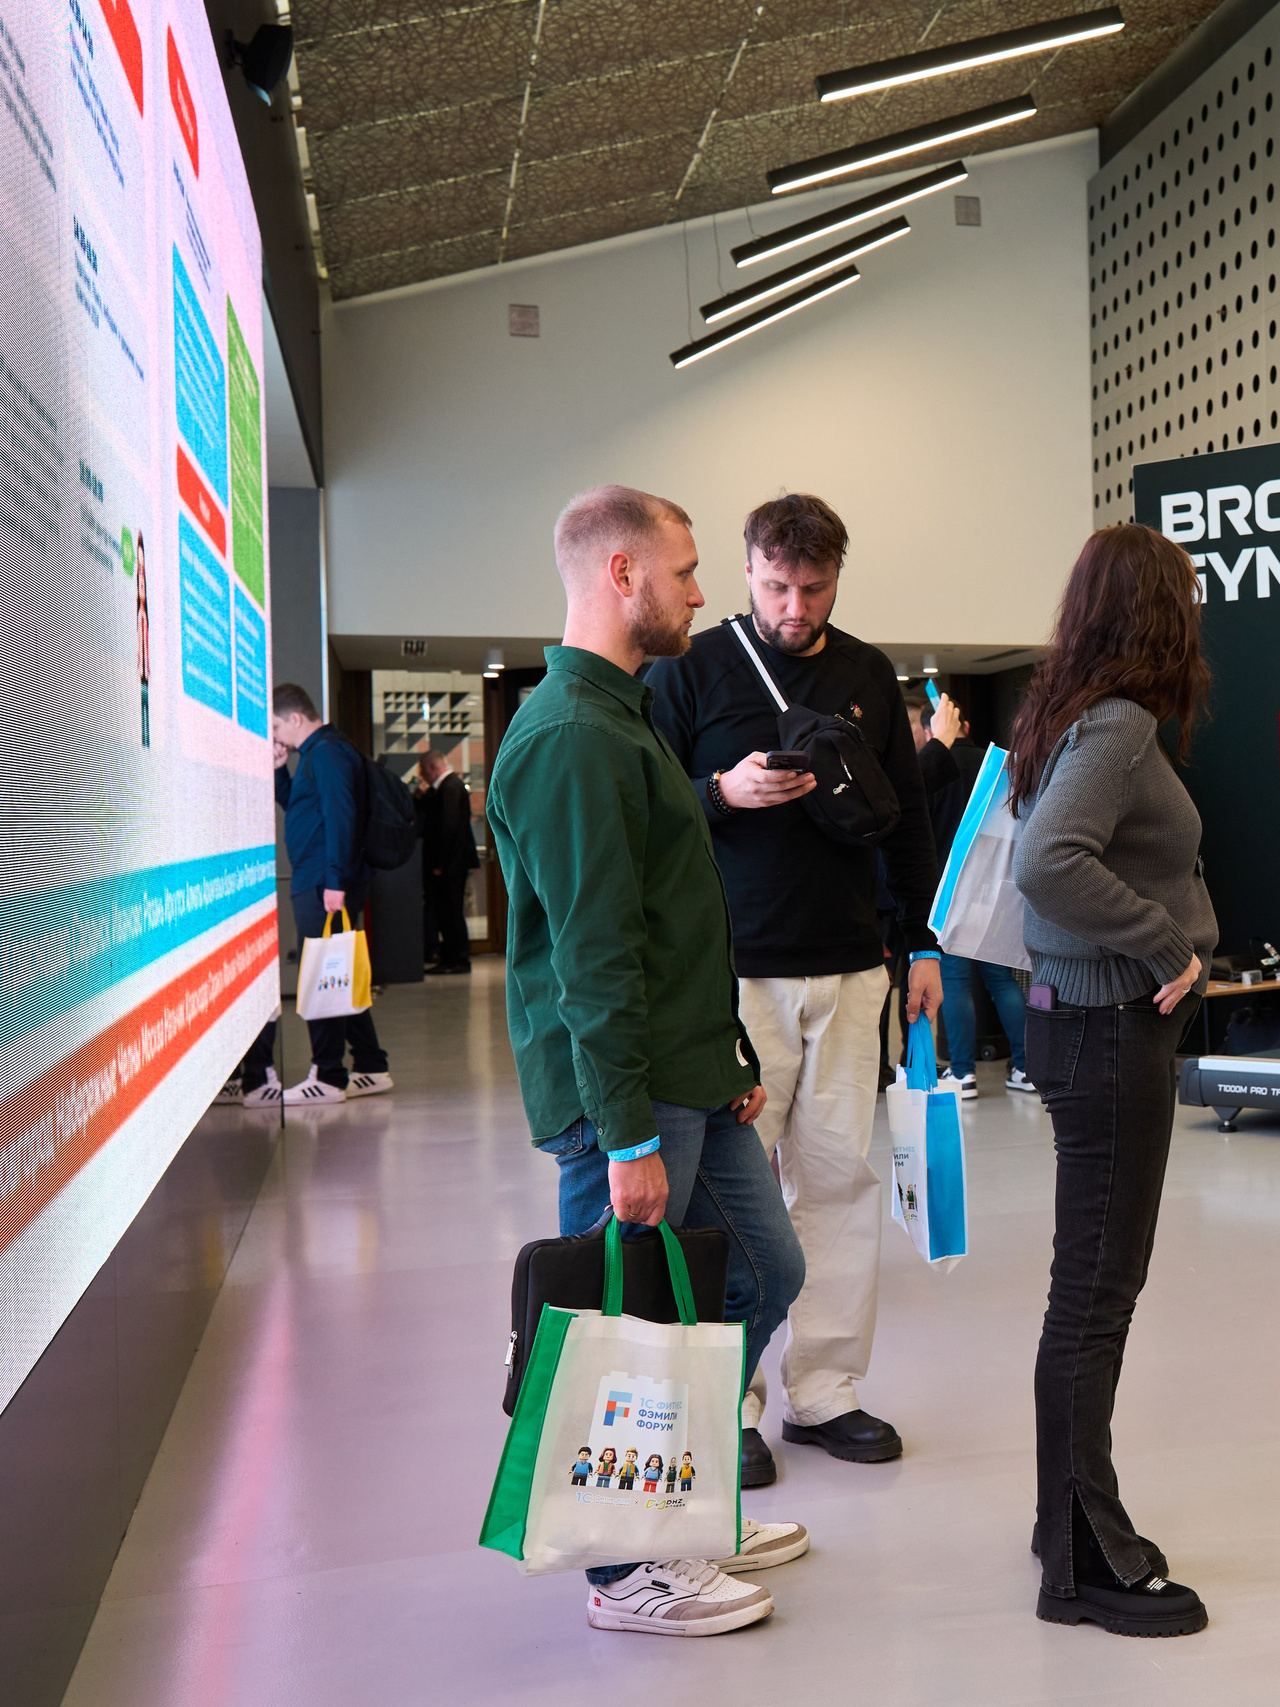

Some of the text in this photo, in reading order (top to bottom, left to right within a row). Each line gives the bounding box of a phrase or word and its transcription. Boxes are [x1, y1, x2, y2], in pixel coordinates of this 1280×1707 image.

[1217, 1084, 1247, 1094] T1000M
[1250, 1086, 1267, 1096] PRO
[636, 1419, 673, 1431] ФОРУМ
